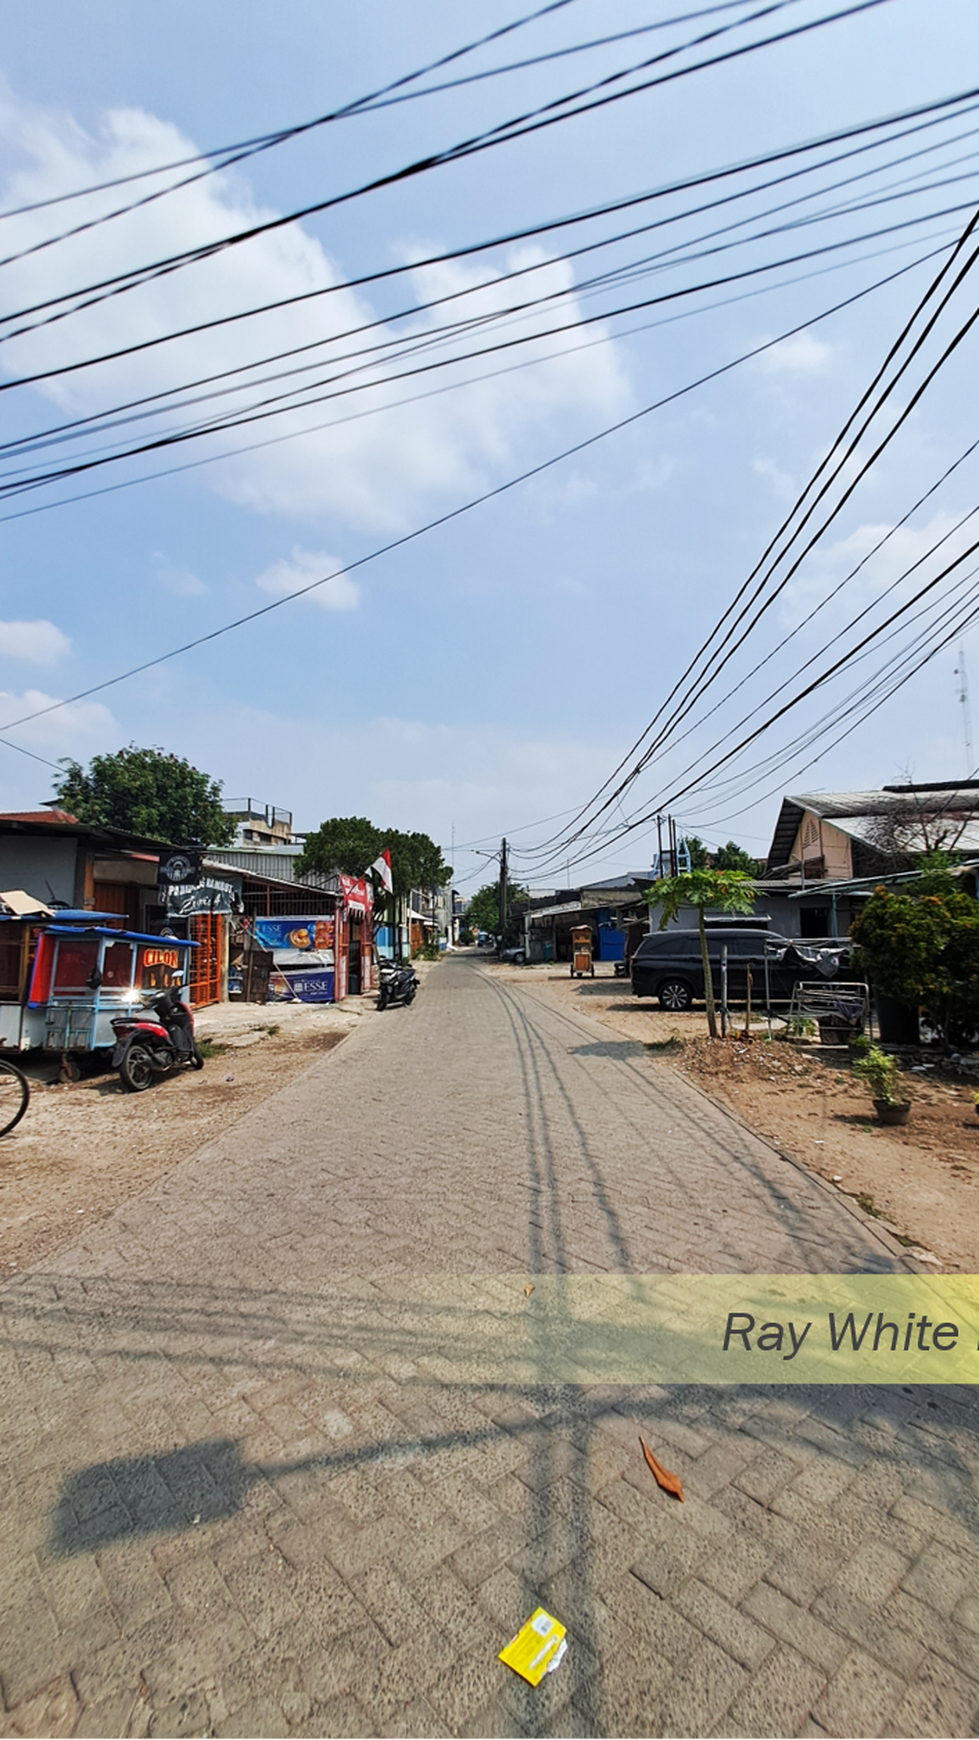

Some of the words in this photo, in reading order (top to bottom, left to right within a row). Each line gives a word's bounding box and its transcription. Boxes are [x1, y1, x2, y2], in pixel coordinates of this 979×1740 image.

[262, 924, 282, 932] ESSE
[144, 948, 179, 969] CILOK
[304, 980, 328, 992] ESSE
